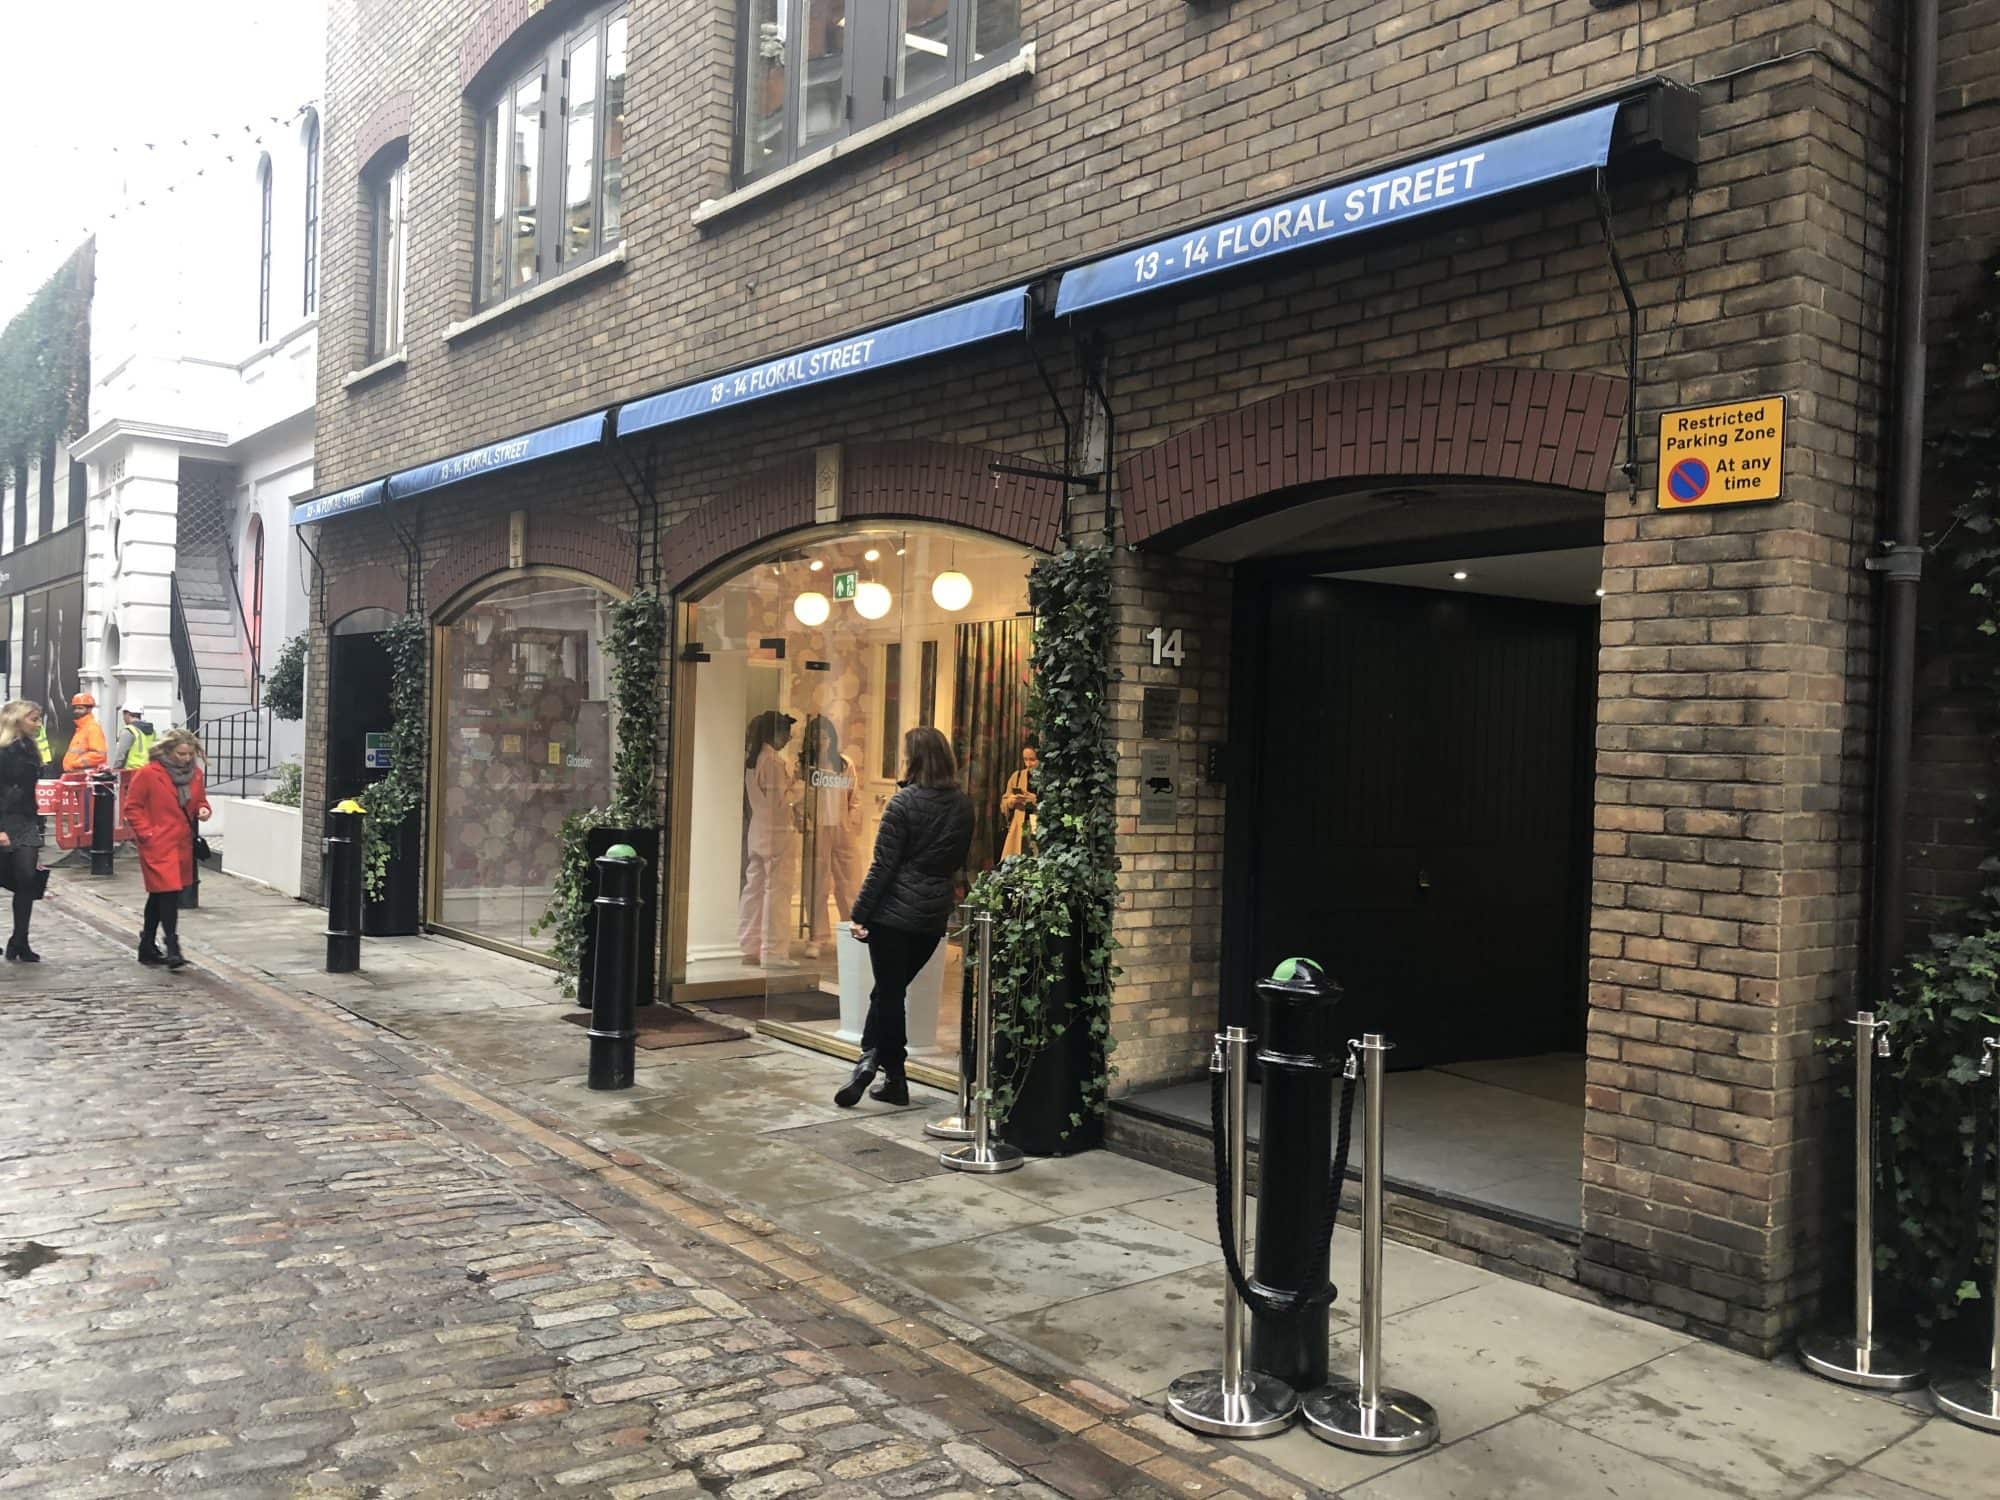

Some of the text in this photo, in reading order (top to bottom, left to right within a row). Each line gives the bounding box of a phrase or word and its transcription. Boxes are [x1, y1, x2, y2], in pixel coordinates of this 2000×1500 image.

[1134, 152, 1485, 283] 13 - 14 FLORAL STREET
[711, 382, 723, 404] 13
[734, 376, 747, 397] 14
[750, 362, 806, 392] FLORAL
[809, 339, 875, 376] STREET
[1678, 406, 1765, 432] Restricted
[1667, 427, 1776, 450] Parking Zone
[494, 439, 529, 464] STREET
[1716, 457, 1771, 473] At any
[1725, 476, 1761, 490] time
[1146, 626, 1185, 666] 14
